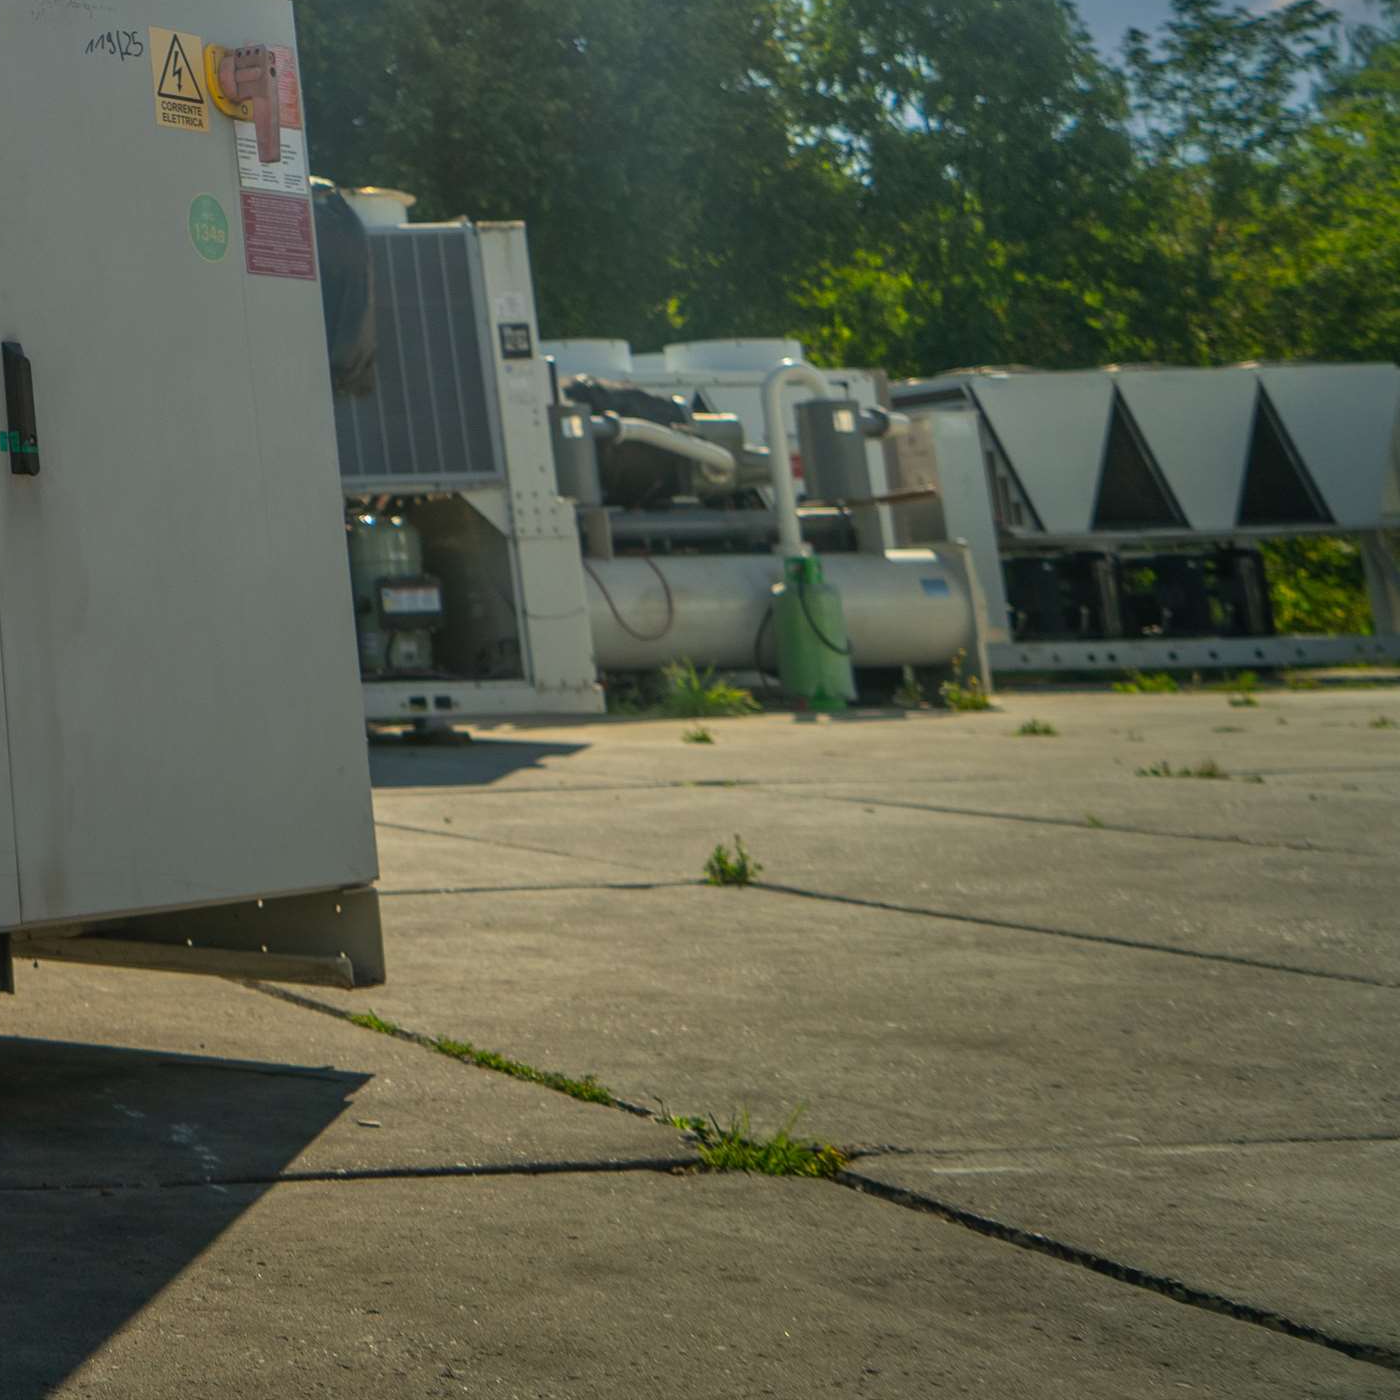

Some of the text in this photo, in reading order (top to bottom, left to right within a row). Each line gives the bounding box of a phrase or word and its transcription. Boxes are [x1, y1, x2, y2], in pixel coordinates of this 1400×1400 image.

[85, 30, 144, 61] 119/25
[161, 101, 203, 116] CORRENTE
[162, 112, 204, 128] ELETTRICA
